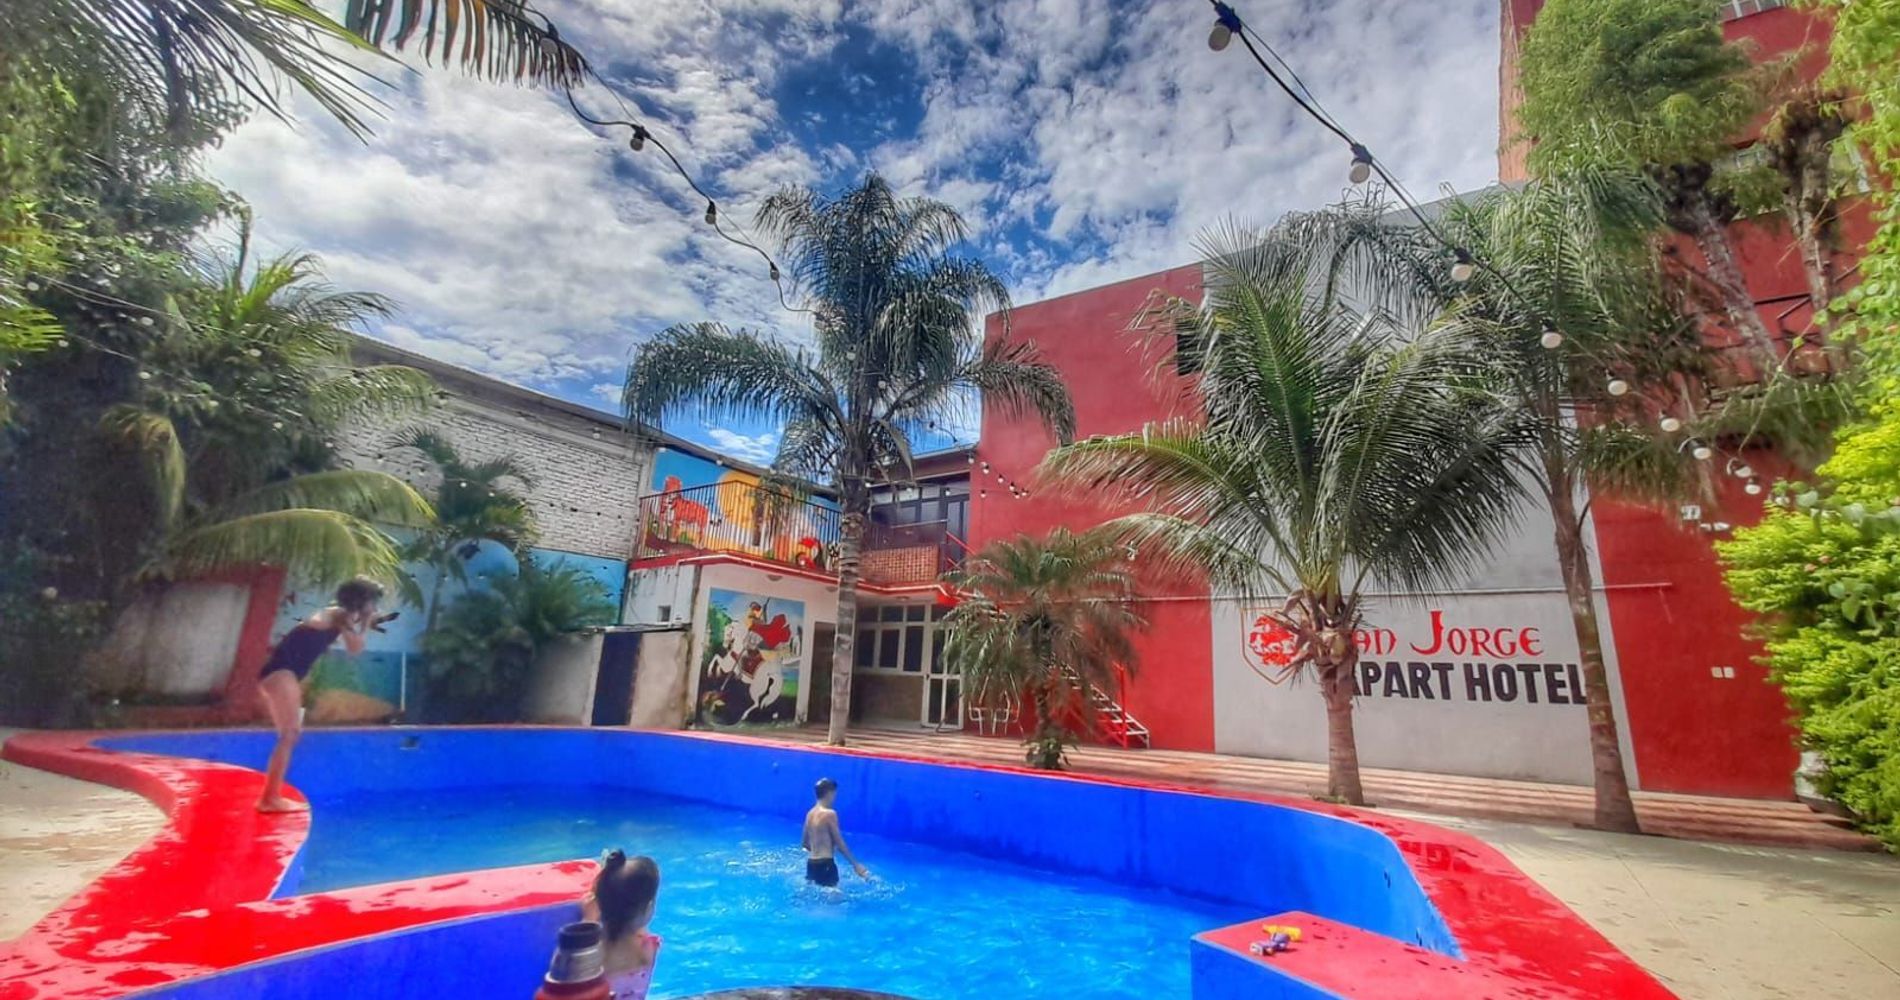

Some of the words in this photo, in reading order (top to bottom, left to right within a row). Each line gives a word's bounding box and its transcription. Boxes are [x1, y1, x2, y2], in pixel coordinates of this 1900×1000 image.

[1350, 626, 1397, 656] AN
[1352, 661, 1454, 700] PART
[1463, 662, 1588, 705] HOTEL
